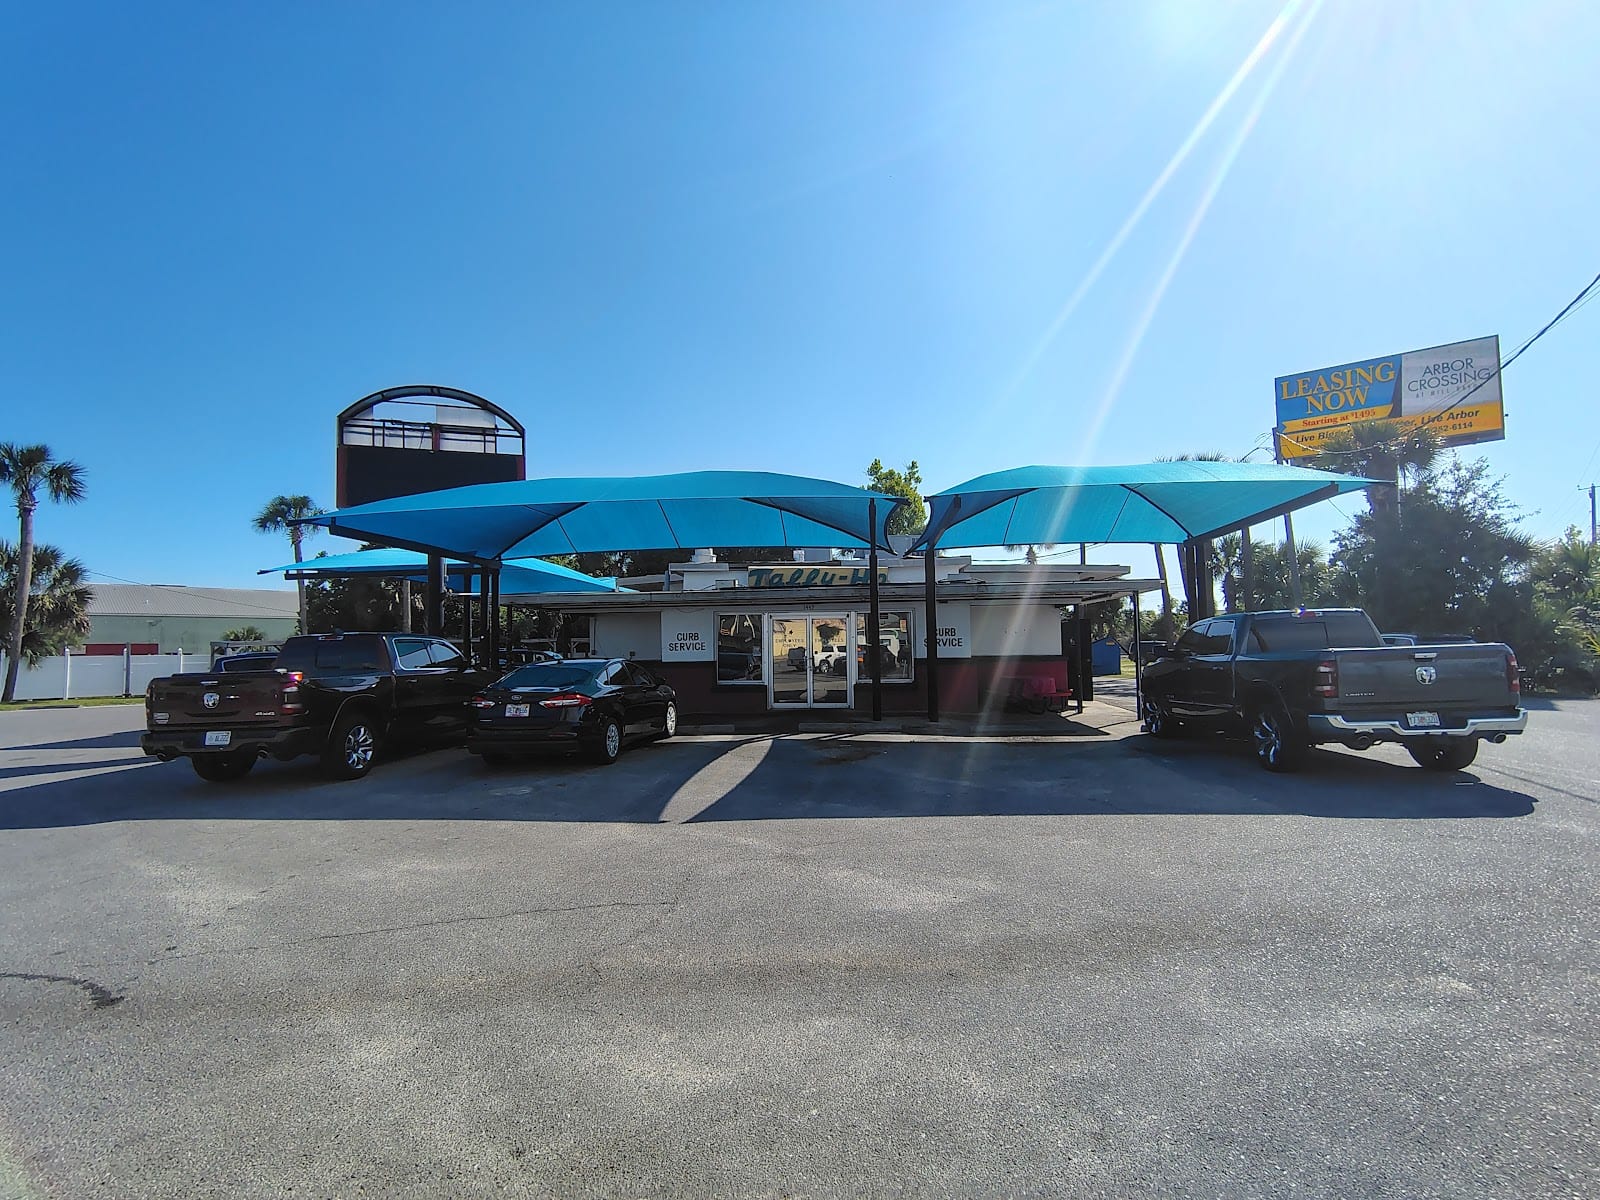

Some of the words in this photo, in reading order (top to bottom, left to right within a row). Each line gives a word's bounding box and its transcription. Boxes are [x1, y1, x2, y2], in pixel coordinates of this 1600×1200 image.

[1422, 357, 1474, 378] ARBOR
[1280, 362, 1396, 400] LEASING
[1407, 368, 1491, 392] CROSSING
[1306, 386, 1369, 414] NOW
[1296, 435, 1315, 443] Live
[1421, 415, 1444, 425] Live
[1447, 410, 1480, 421] Arbor
[1302, 416, 1339, 427] Starting
[676, 632, 700, 642] CURB
[935, 627, 956, 637] URB
[668, 641, 706, 652] SERVICE
[923, 637, 963, 648] SRVICE
